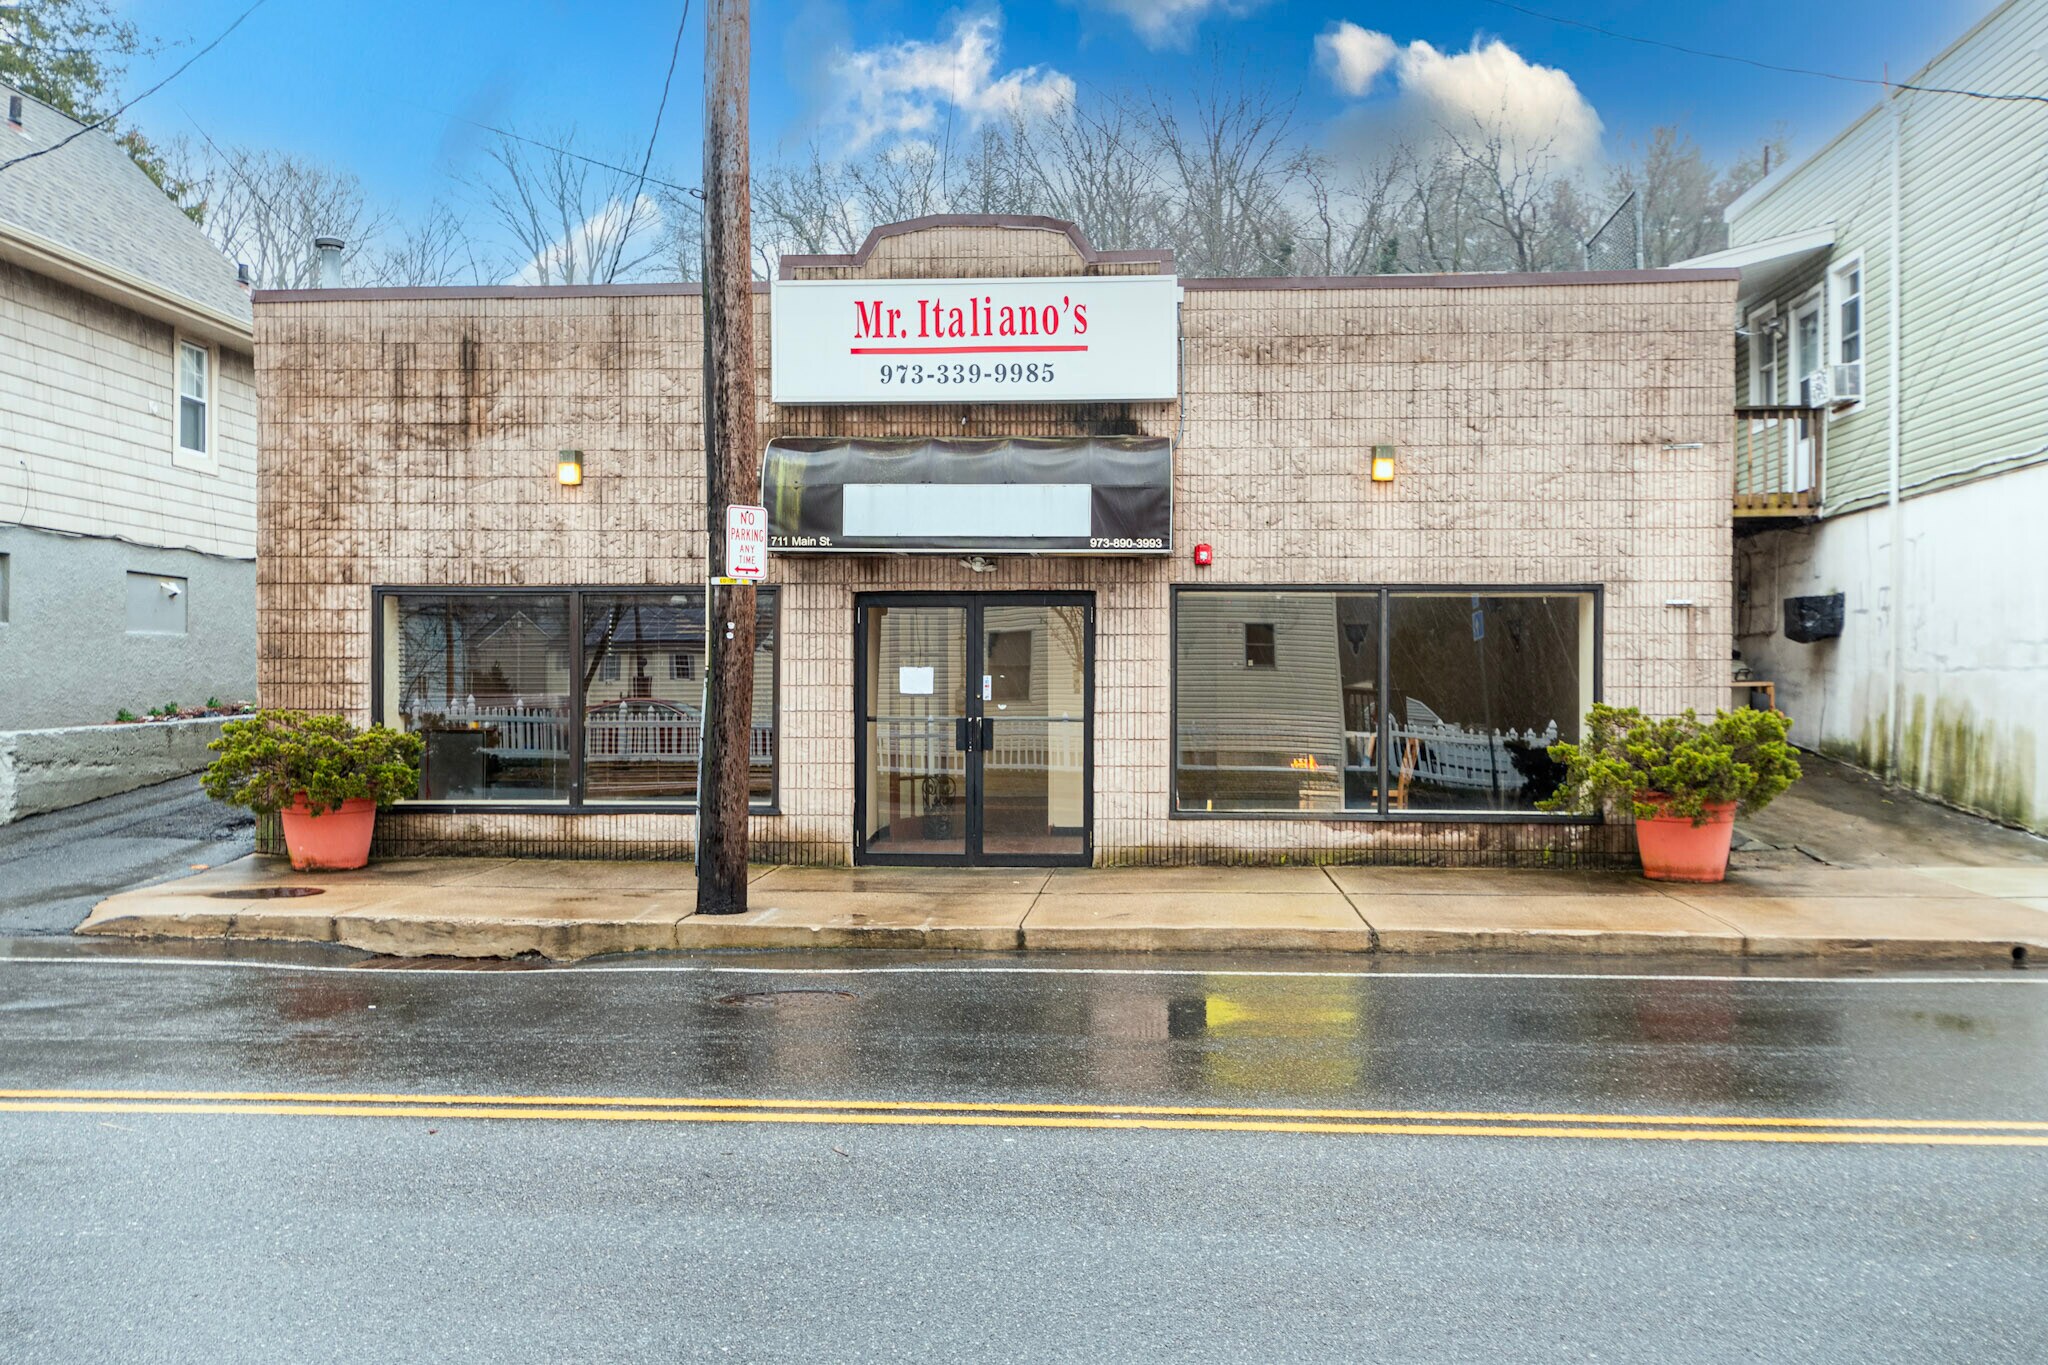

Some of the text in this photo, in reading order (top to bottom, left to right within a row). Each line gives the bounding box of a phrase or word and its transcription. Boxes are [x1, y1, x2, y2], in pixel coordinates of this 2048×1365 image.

[854, 295, 1088, 339] Mr. Italiano's
[880, 362, 1055, 385] 973-339-9985
[740, 512, 755, 526] NO
[731, 528, 764, 543] PARKING
[771, 536, 833, 547] 711 Main St.
[740, 545, 755, 554] ANY
[1089, 537, 1163, 549] 973-890-3993
[739, 555, 756, 565] TIME
